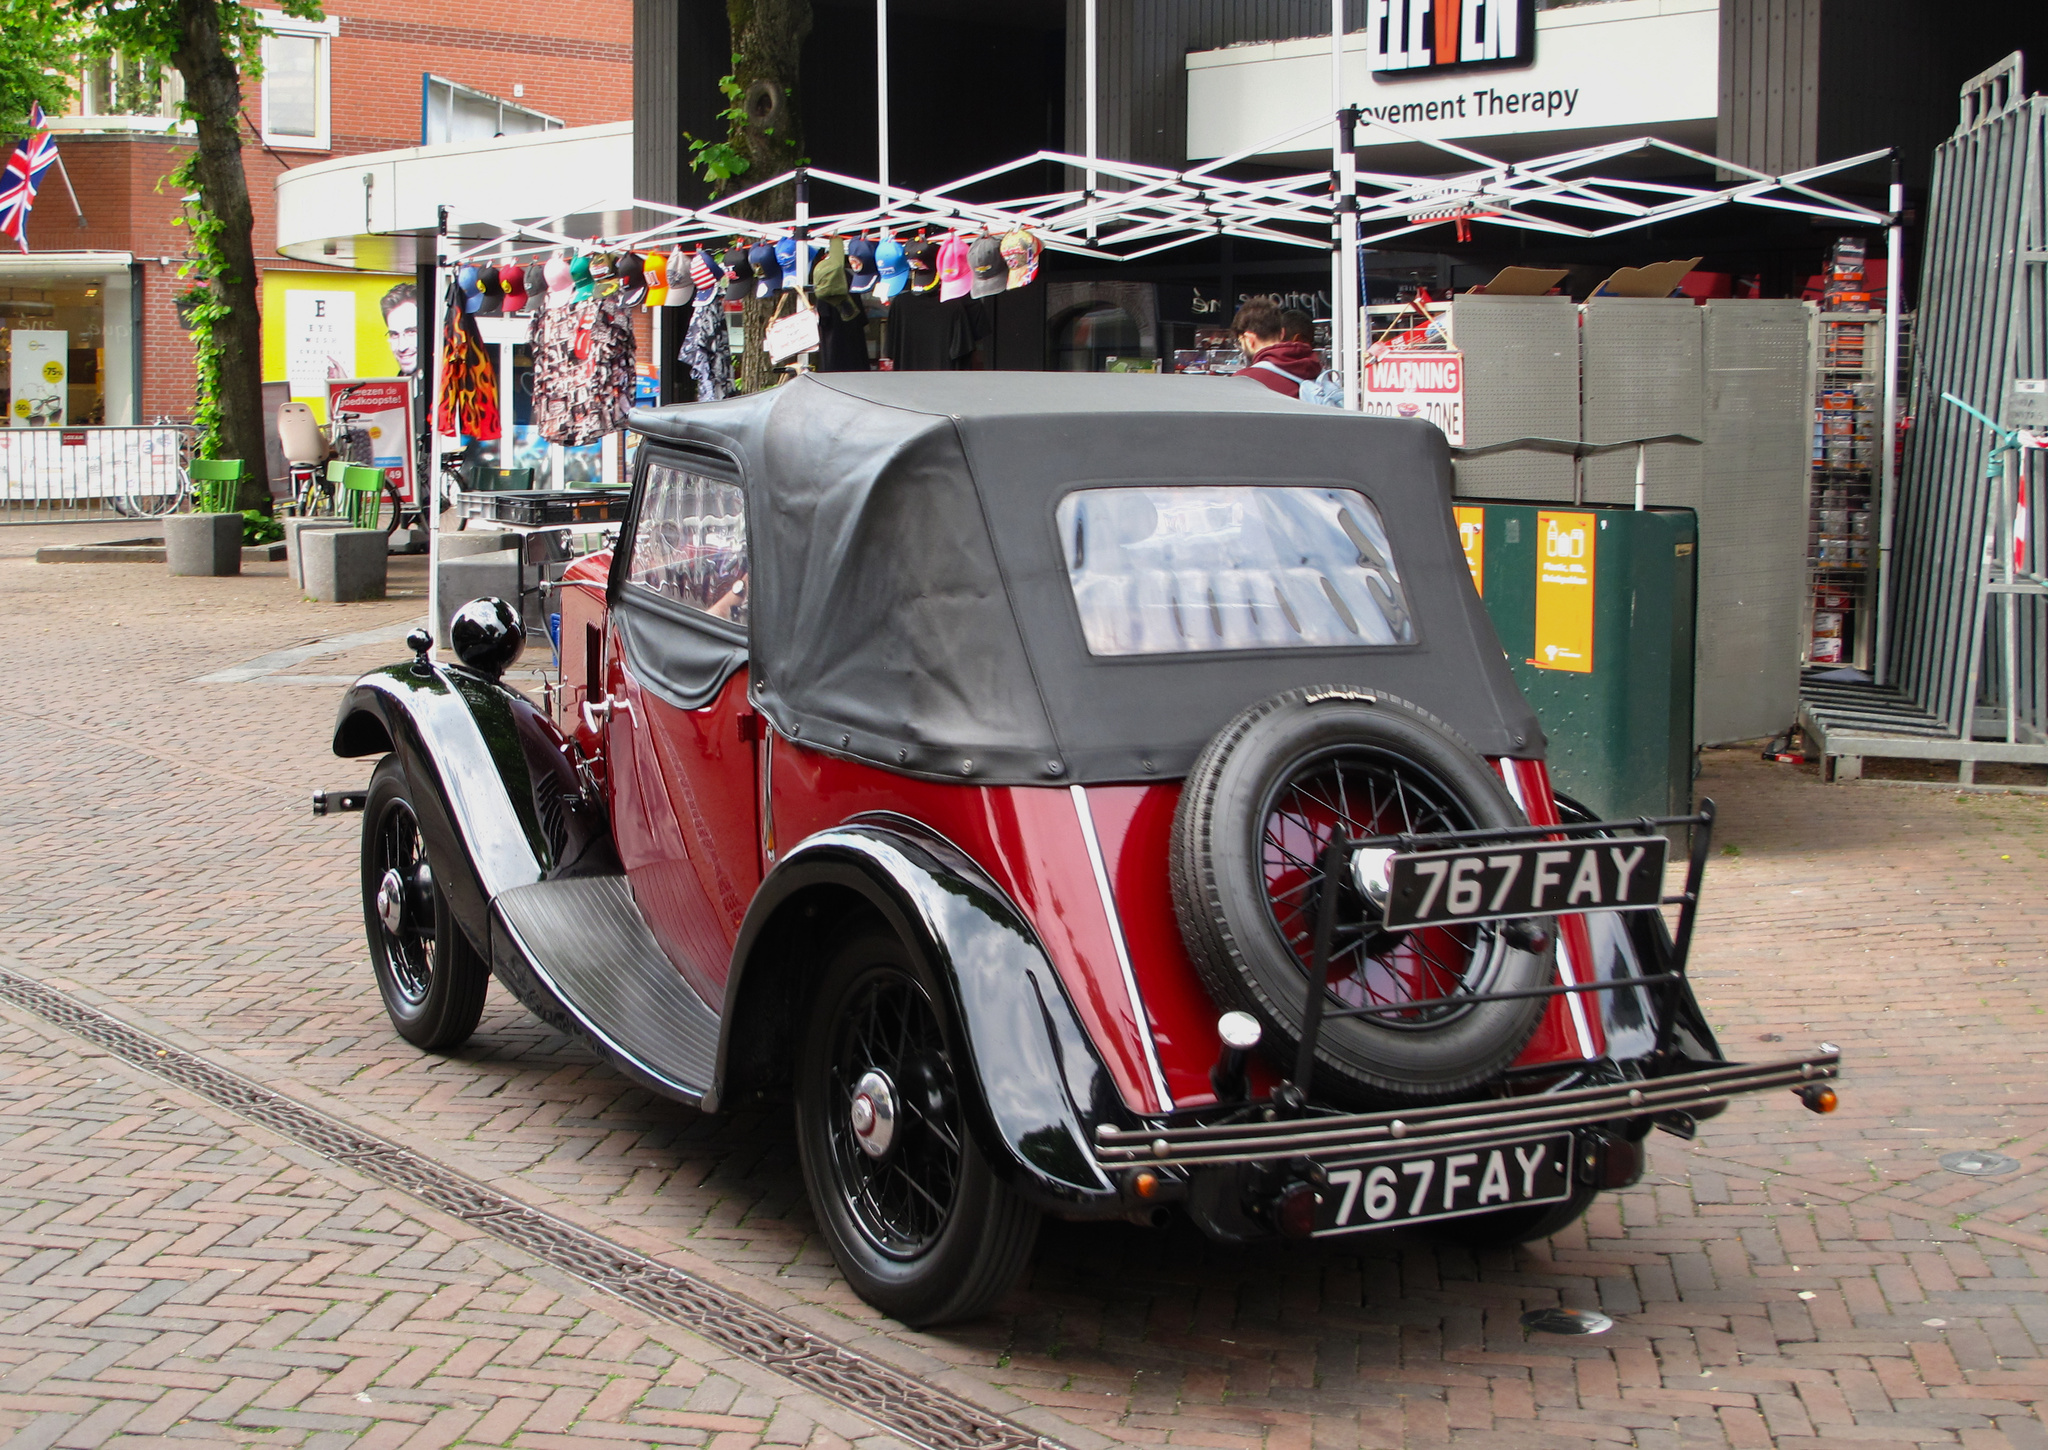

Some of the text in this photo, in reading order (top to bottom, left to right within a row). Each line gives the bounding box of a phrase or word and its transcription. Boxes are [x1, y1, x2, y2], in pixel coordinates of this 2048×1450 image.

[1474, 88, 1579, 118] Therapy
[315, 300, 325, 317] E
[1373, 361, 1457, 390] WARNING
[386, 386, 397, 396] de
[1414, 845, 1646, 919] 767 FAY
[1327, 1143, 1547, 1227] 767 FAY
